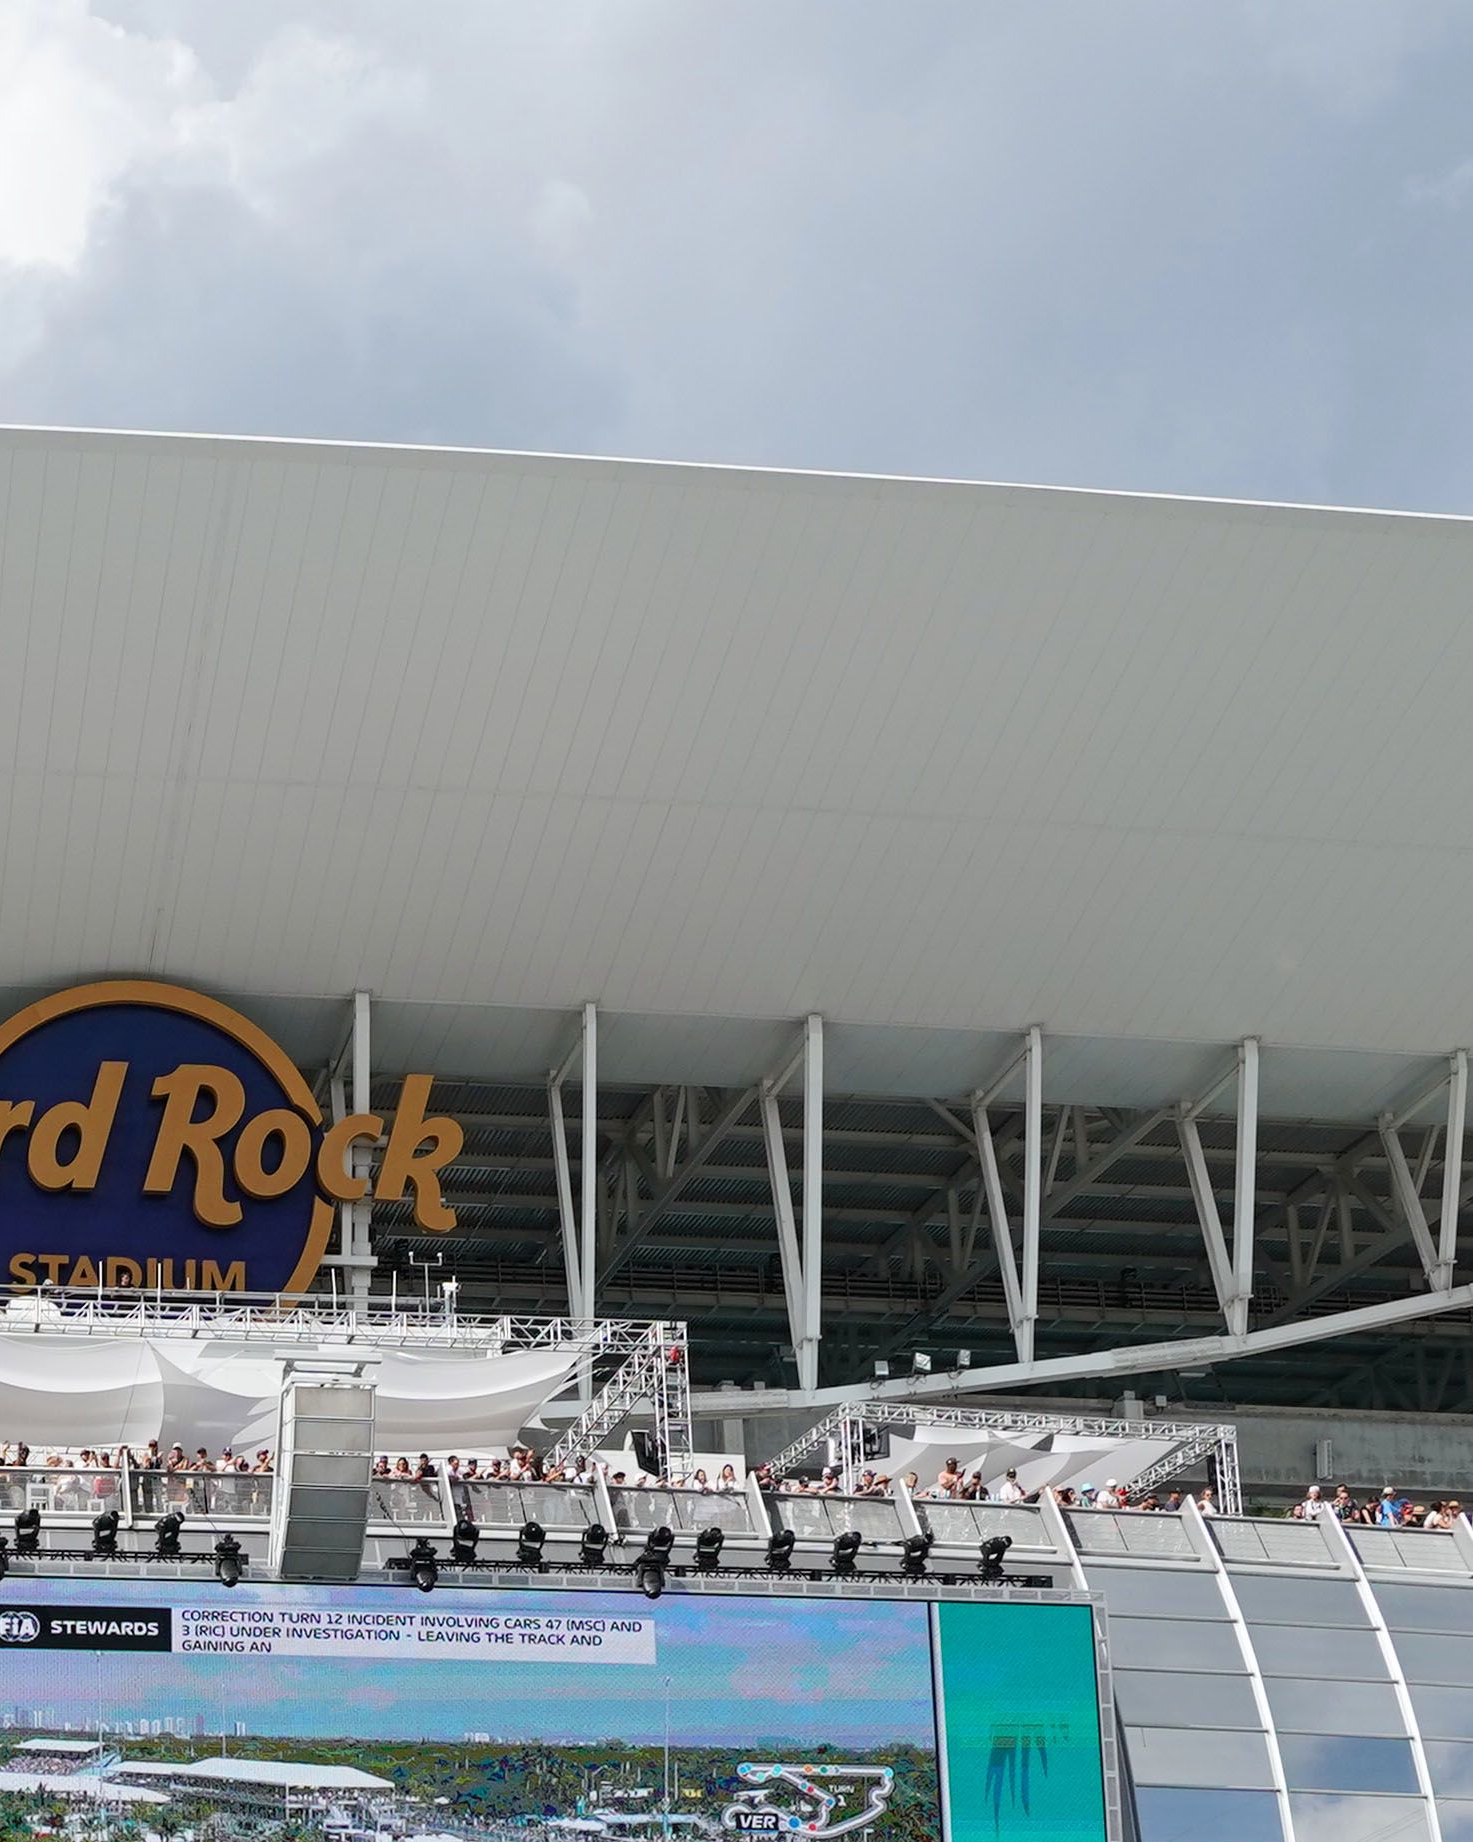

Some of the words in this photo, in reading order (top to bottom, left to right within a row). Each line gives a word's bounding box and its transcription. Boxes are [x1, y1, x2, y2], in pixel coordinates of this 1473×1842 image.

[143, 1064, 465, 1233] Rock
[8, 1252, 245, 1296] STADIUM
[51, 1620, 159, 1636] STEWARDS
[182, 1610, 274, 1624] CORRECTION
[280, 1612, 324, 1625] TURN
[327, 1613, 343, 1625] 12
[348, 1614, 415, 1626] INCIDENT
[421, 1616, 500, 1629] INVOLVING
[504, 1617, 541, 1630] CARS
[545, 1618, 561, 1630] 47
[566, 1619, 606, 1632] (MSC)
[610, 1621, 642, 1633] AND
[182, 1625, 190, 1636] 3
[195, 1625, 225, 1638] (RIC)
[230, 1626, 281, 1638] UNDER
[286, 1627, 400, 1641] INVESTIGATION
[418, 1631, 481, 1644] LEAVING
[485, 1632, 514, 1644] THE
[519, 1633, 566, 1645] TRACK
[570, 1635, 602, 1646] AND
[182, 1640, 246, 1652] GAINING
[250, 1641, 272, 1653] AN
[739, 1815, 776, 1829] VER
